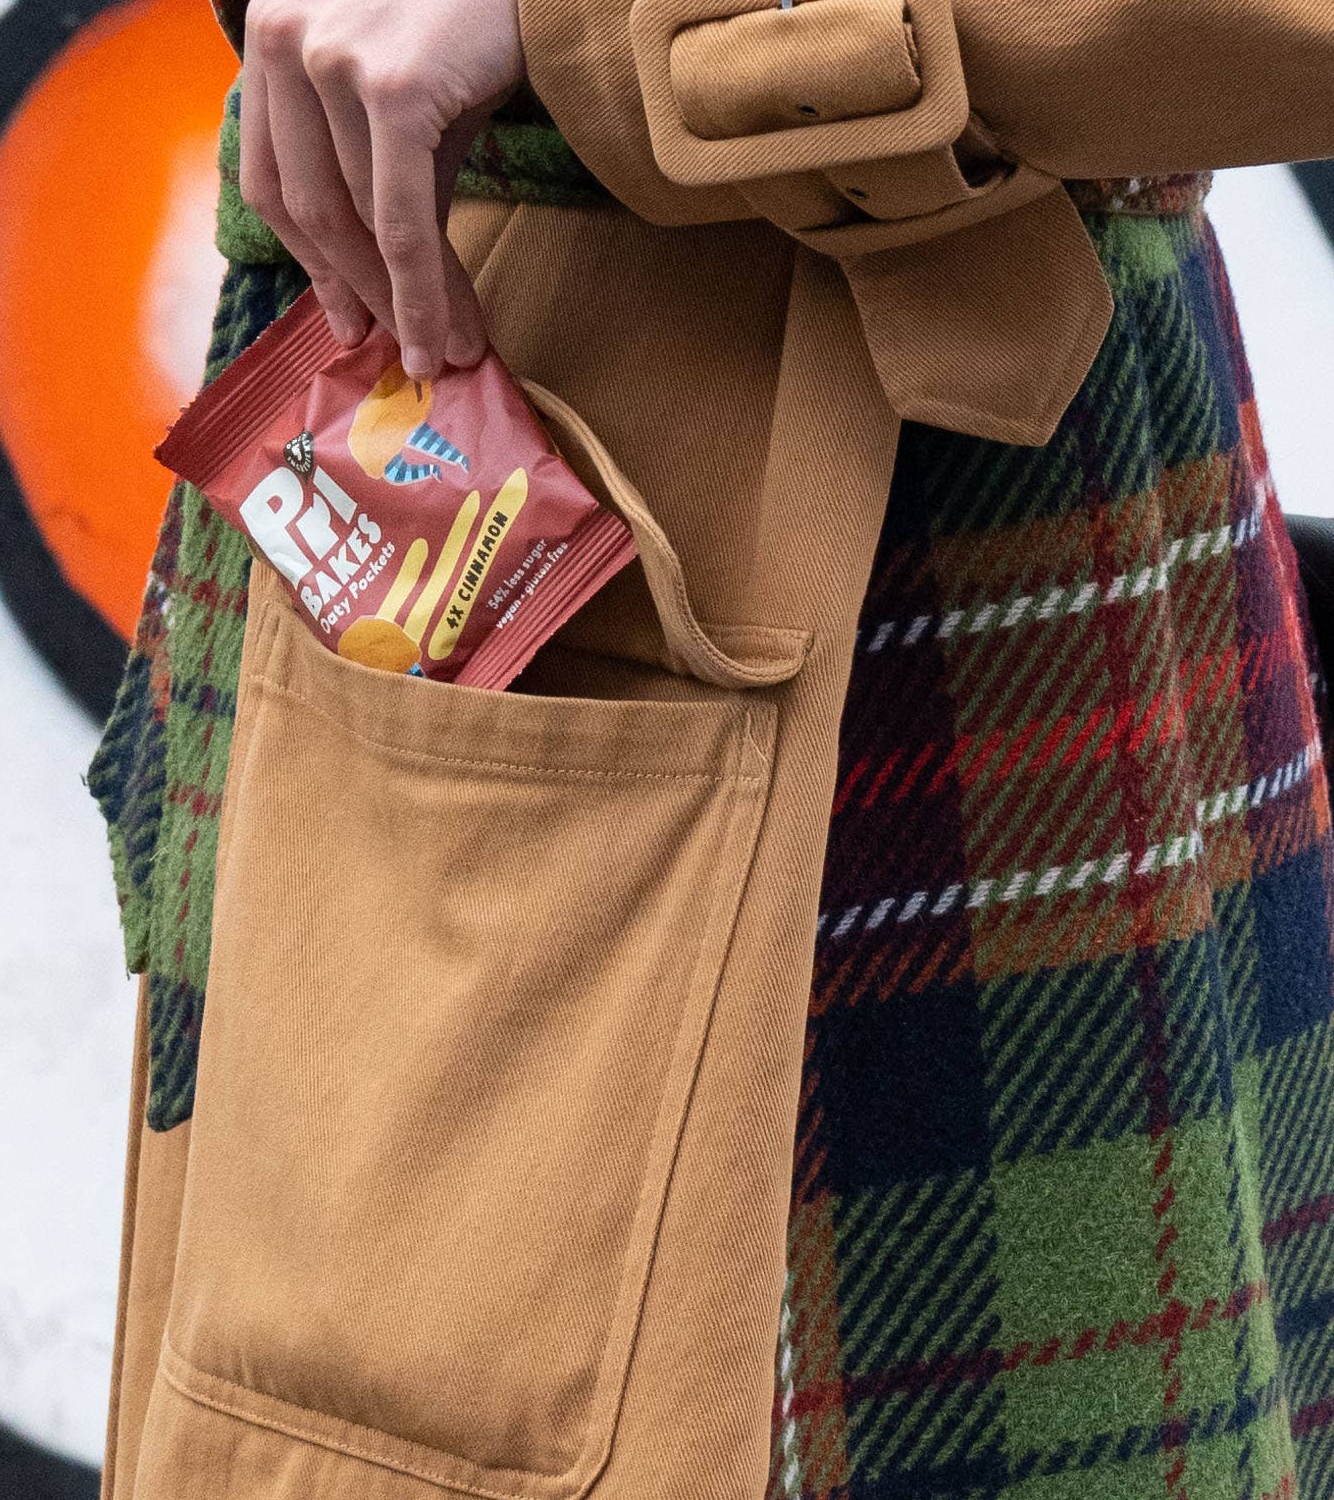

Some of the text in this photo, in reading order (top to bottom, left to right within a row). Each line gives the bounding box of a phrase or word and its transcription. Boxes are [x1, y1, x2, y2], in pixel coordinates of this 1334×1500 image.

[301, 513, 381, 620] BAKES
[320, 541, 396, 634] Oaty Pockets
[458, 511, 508, 602] CINNAMON
[487, 539, 547, 610] 54% less sugar
[496, 542, 568, 629] vegan gluten free
